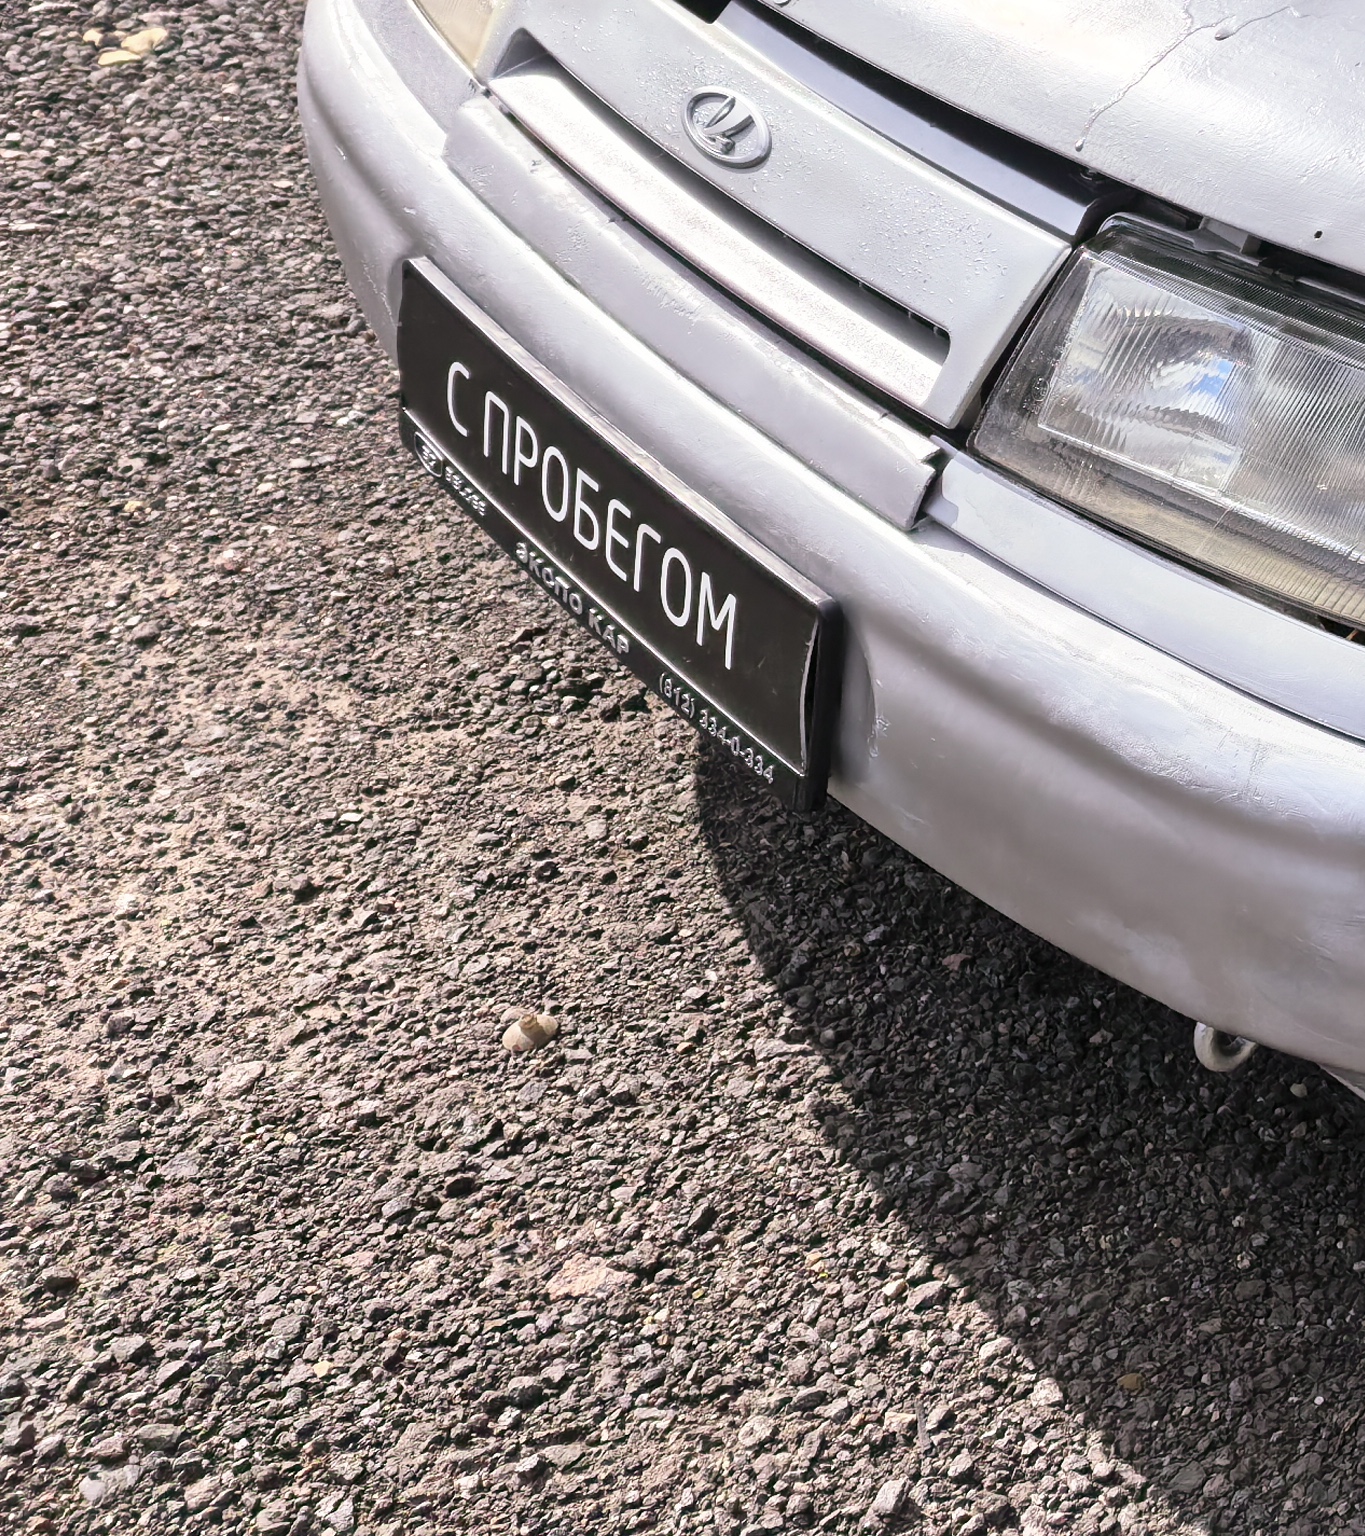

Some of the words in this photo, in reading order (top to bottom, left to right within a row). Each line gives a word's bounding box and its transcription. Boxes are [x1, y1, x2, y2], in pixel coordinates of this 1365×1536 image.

[447, 361, 470, 437] С
[483, 391, 737, 670] ПРОБЕГОМ
[588, 607, 630, 655] КАР
[659, 671, 696, 719] (812)
[699, 709, 775, 785] 334-0-334
